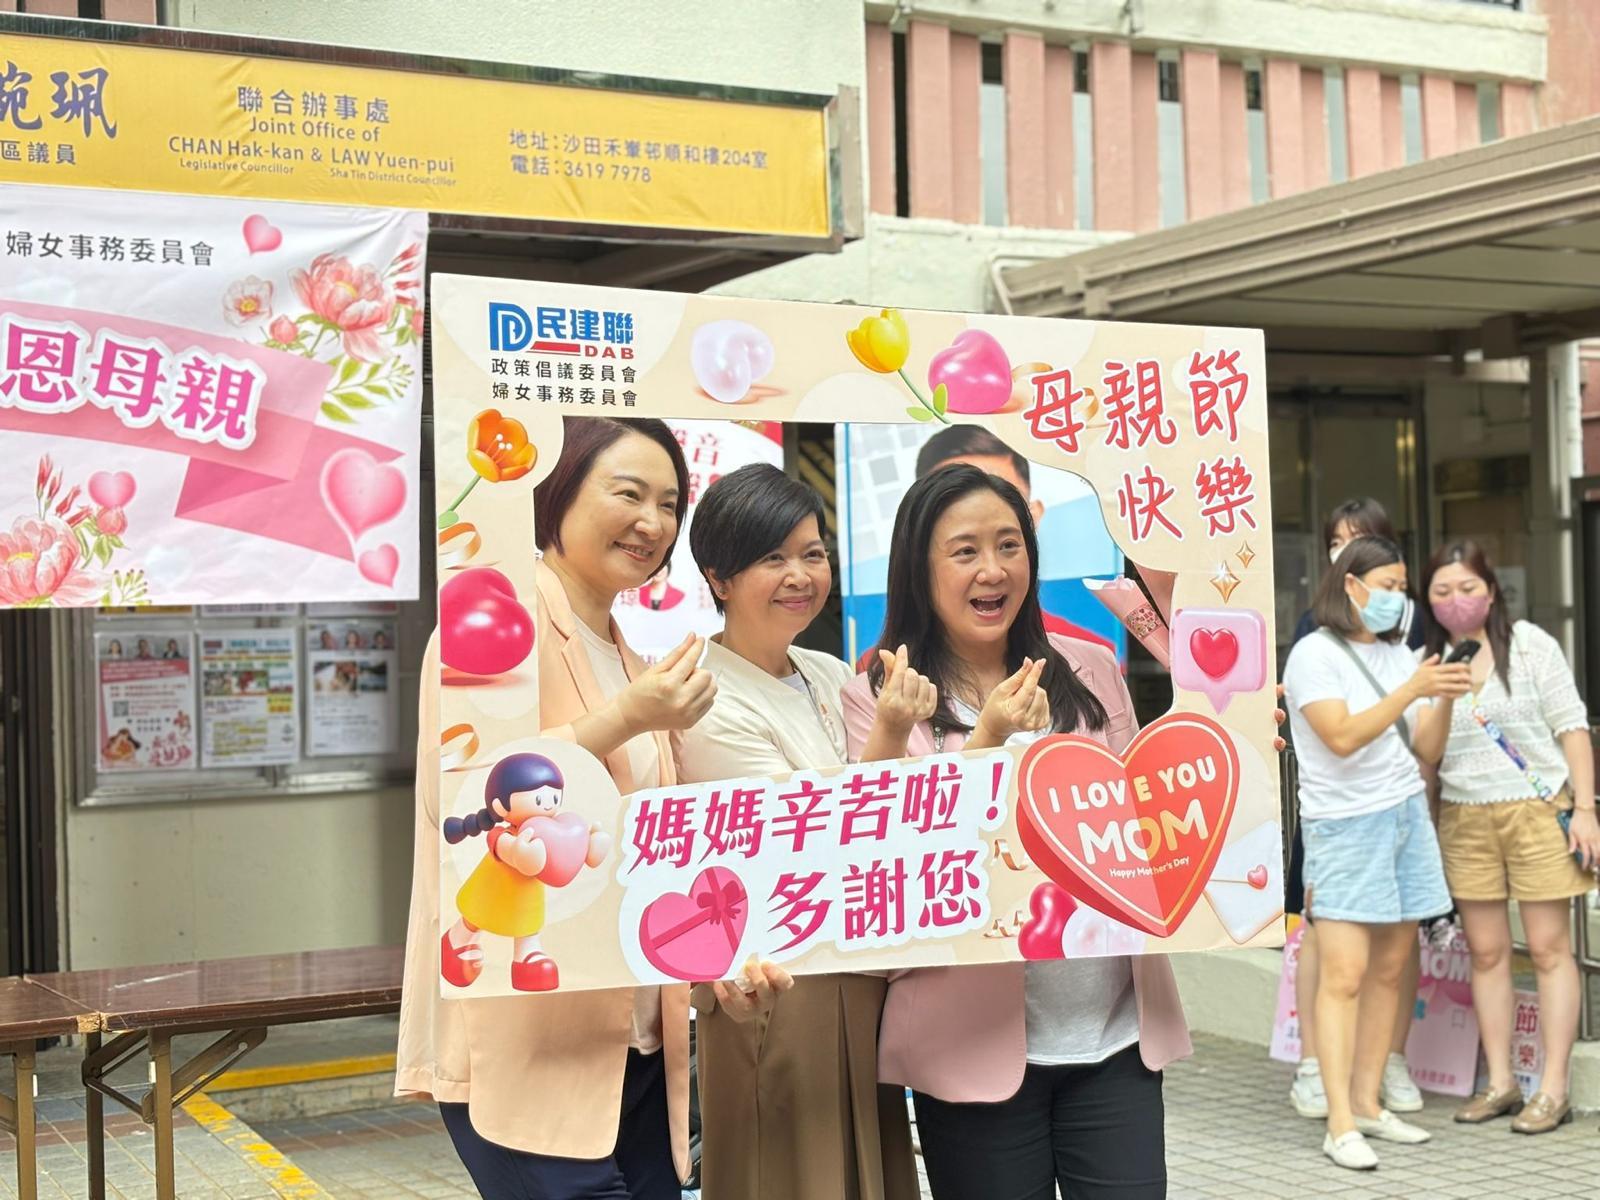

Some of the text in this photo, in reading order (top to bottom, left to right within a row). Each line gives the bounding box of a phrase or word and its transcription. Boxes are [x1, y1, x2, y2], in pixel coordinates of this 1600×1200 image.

[237, 86, 390, 124] 聯合辦事處
[250, 116, 380, 142] Joint Office of
[1, 139, 76, 165] 區議員
[169, 136, 454, 174] CHAN Hak-kan & LAW Yuen-pui
[180, 157, 294, 174] Legislative Councillor
[330, 167, 456, 187] Sha Tin District Councillor
[611, 165, 651, 183] 7978
[6, 230, 214, 267] 婦女事務委員會
[537, 306, 634, 344] 民建聯
[491, 358, 636, 383] 政策倡議委員會
[584, 345, 634, 359] DAB
[0, 323, 256, 440] 恩母親
[492, 382, 637, 407] 婦女事務委員會
[1023, 349, 1248, 453] 母親節
[1118, 456, 1256, 541] 快樂
[1048, 787, 1061, 813] I
[1157, 755, 1216, 794] YOU
[627, 761, 1004, 875] 媽媽辛苦啦！
[1076, 798, 1209, 865] MOM
[1108, 855, 1190, 879] Happy Mother's Day
[766, 849, 982, 955] 多謝您
